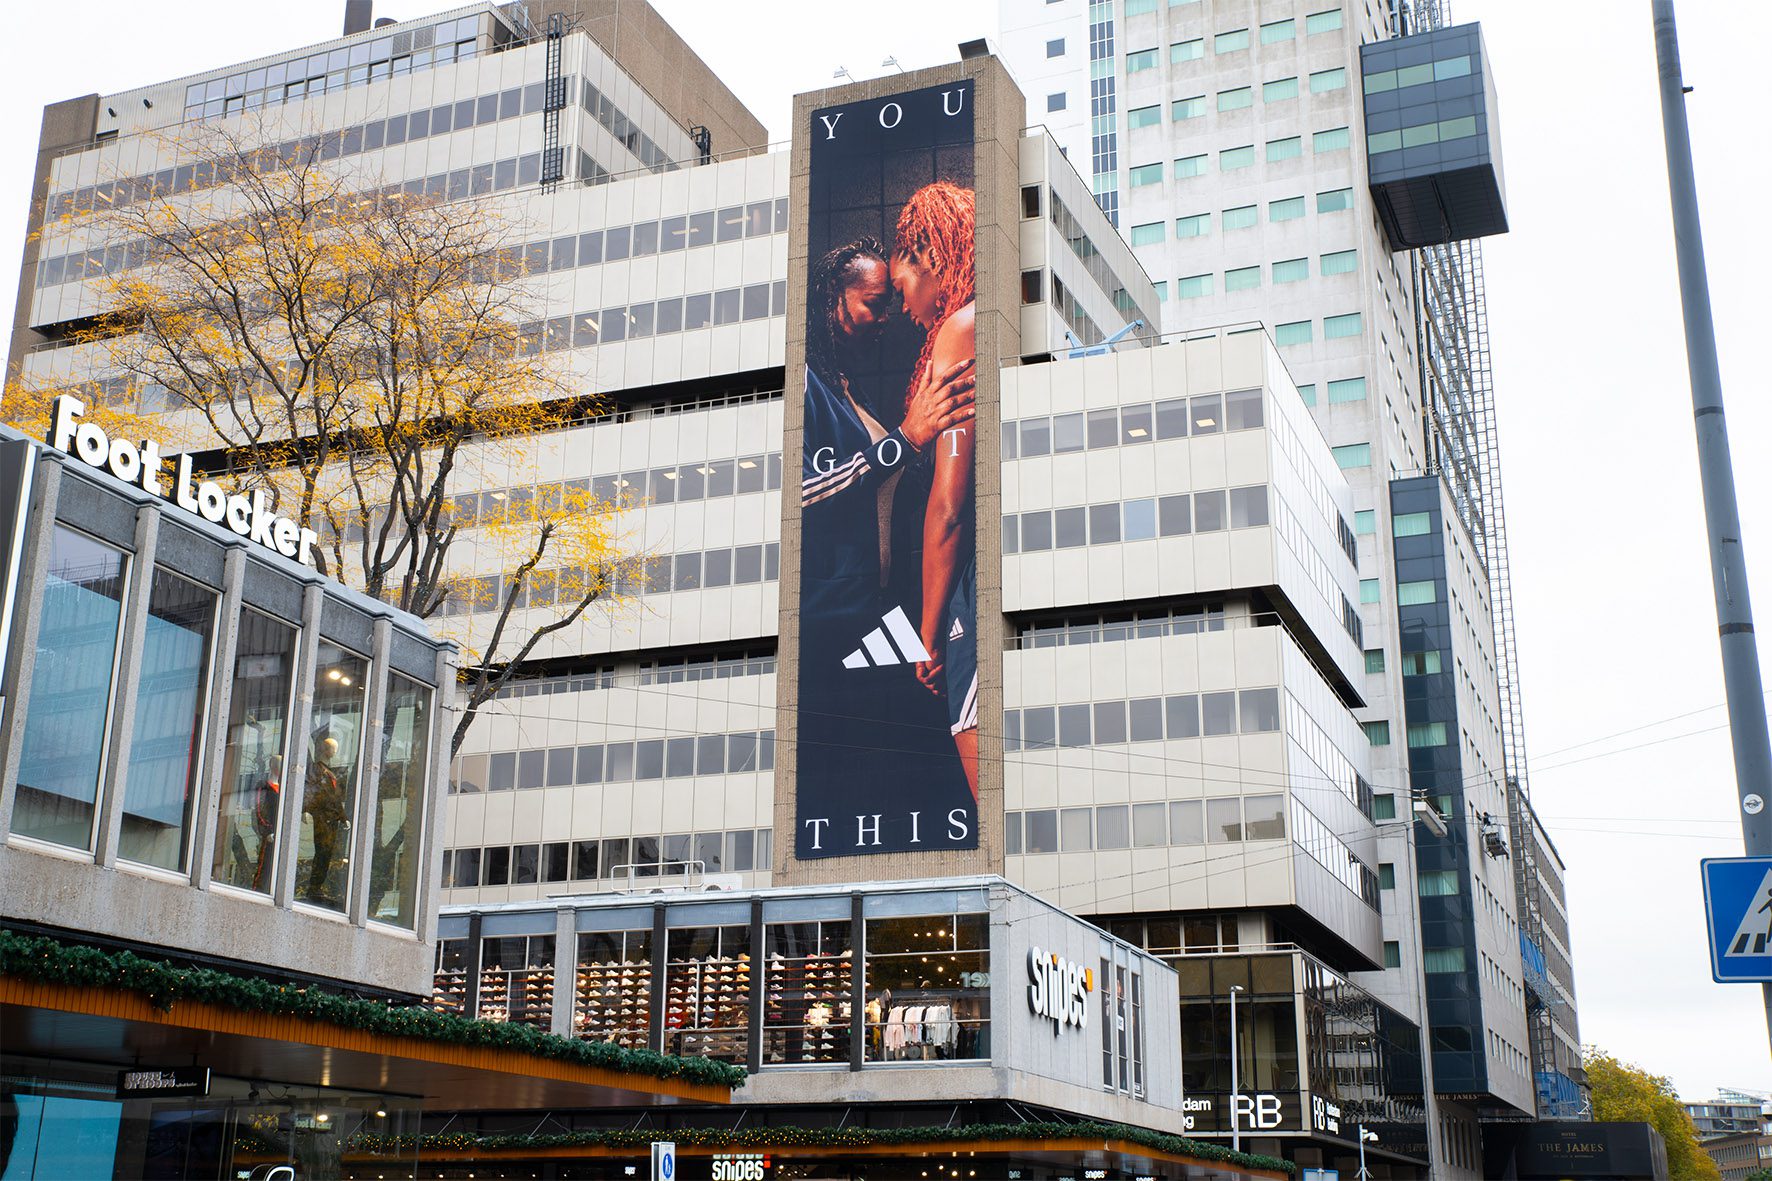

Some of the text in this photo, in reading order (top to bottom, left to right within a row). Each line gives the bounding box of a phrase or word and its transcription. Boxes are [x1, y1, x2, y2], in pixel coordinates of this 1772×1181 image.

[820, 88, 966, 140] YOU
[812, 428, 967, 478] GOT
[51, 394, 318, 565] Foot Locker
[805, 808, 969, 850] THIS
[1027, 946, 1088, 1037] snipes
[1230, 1095, 1282, 1128] RB
[712, 1160, 764, 1181] snipes
[1537, 1143, 1605, 1153] THE JAMES
